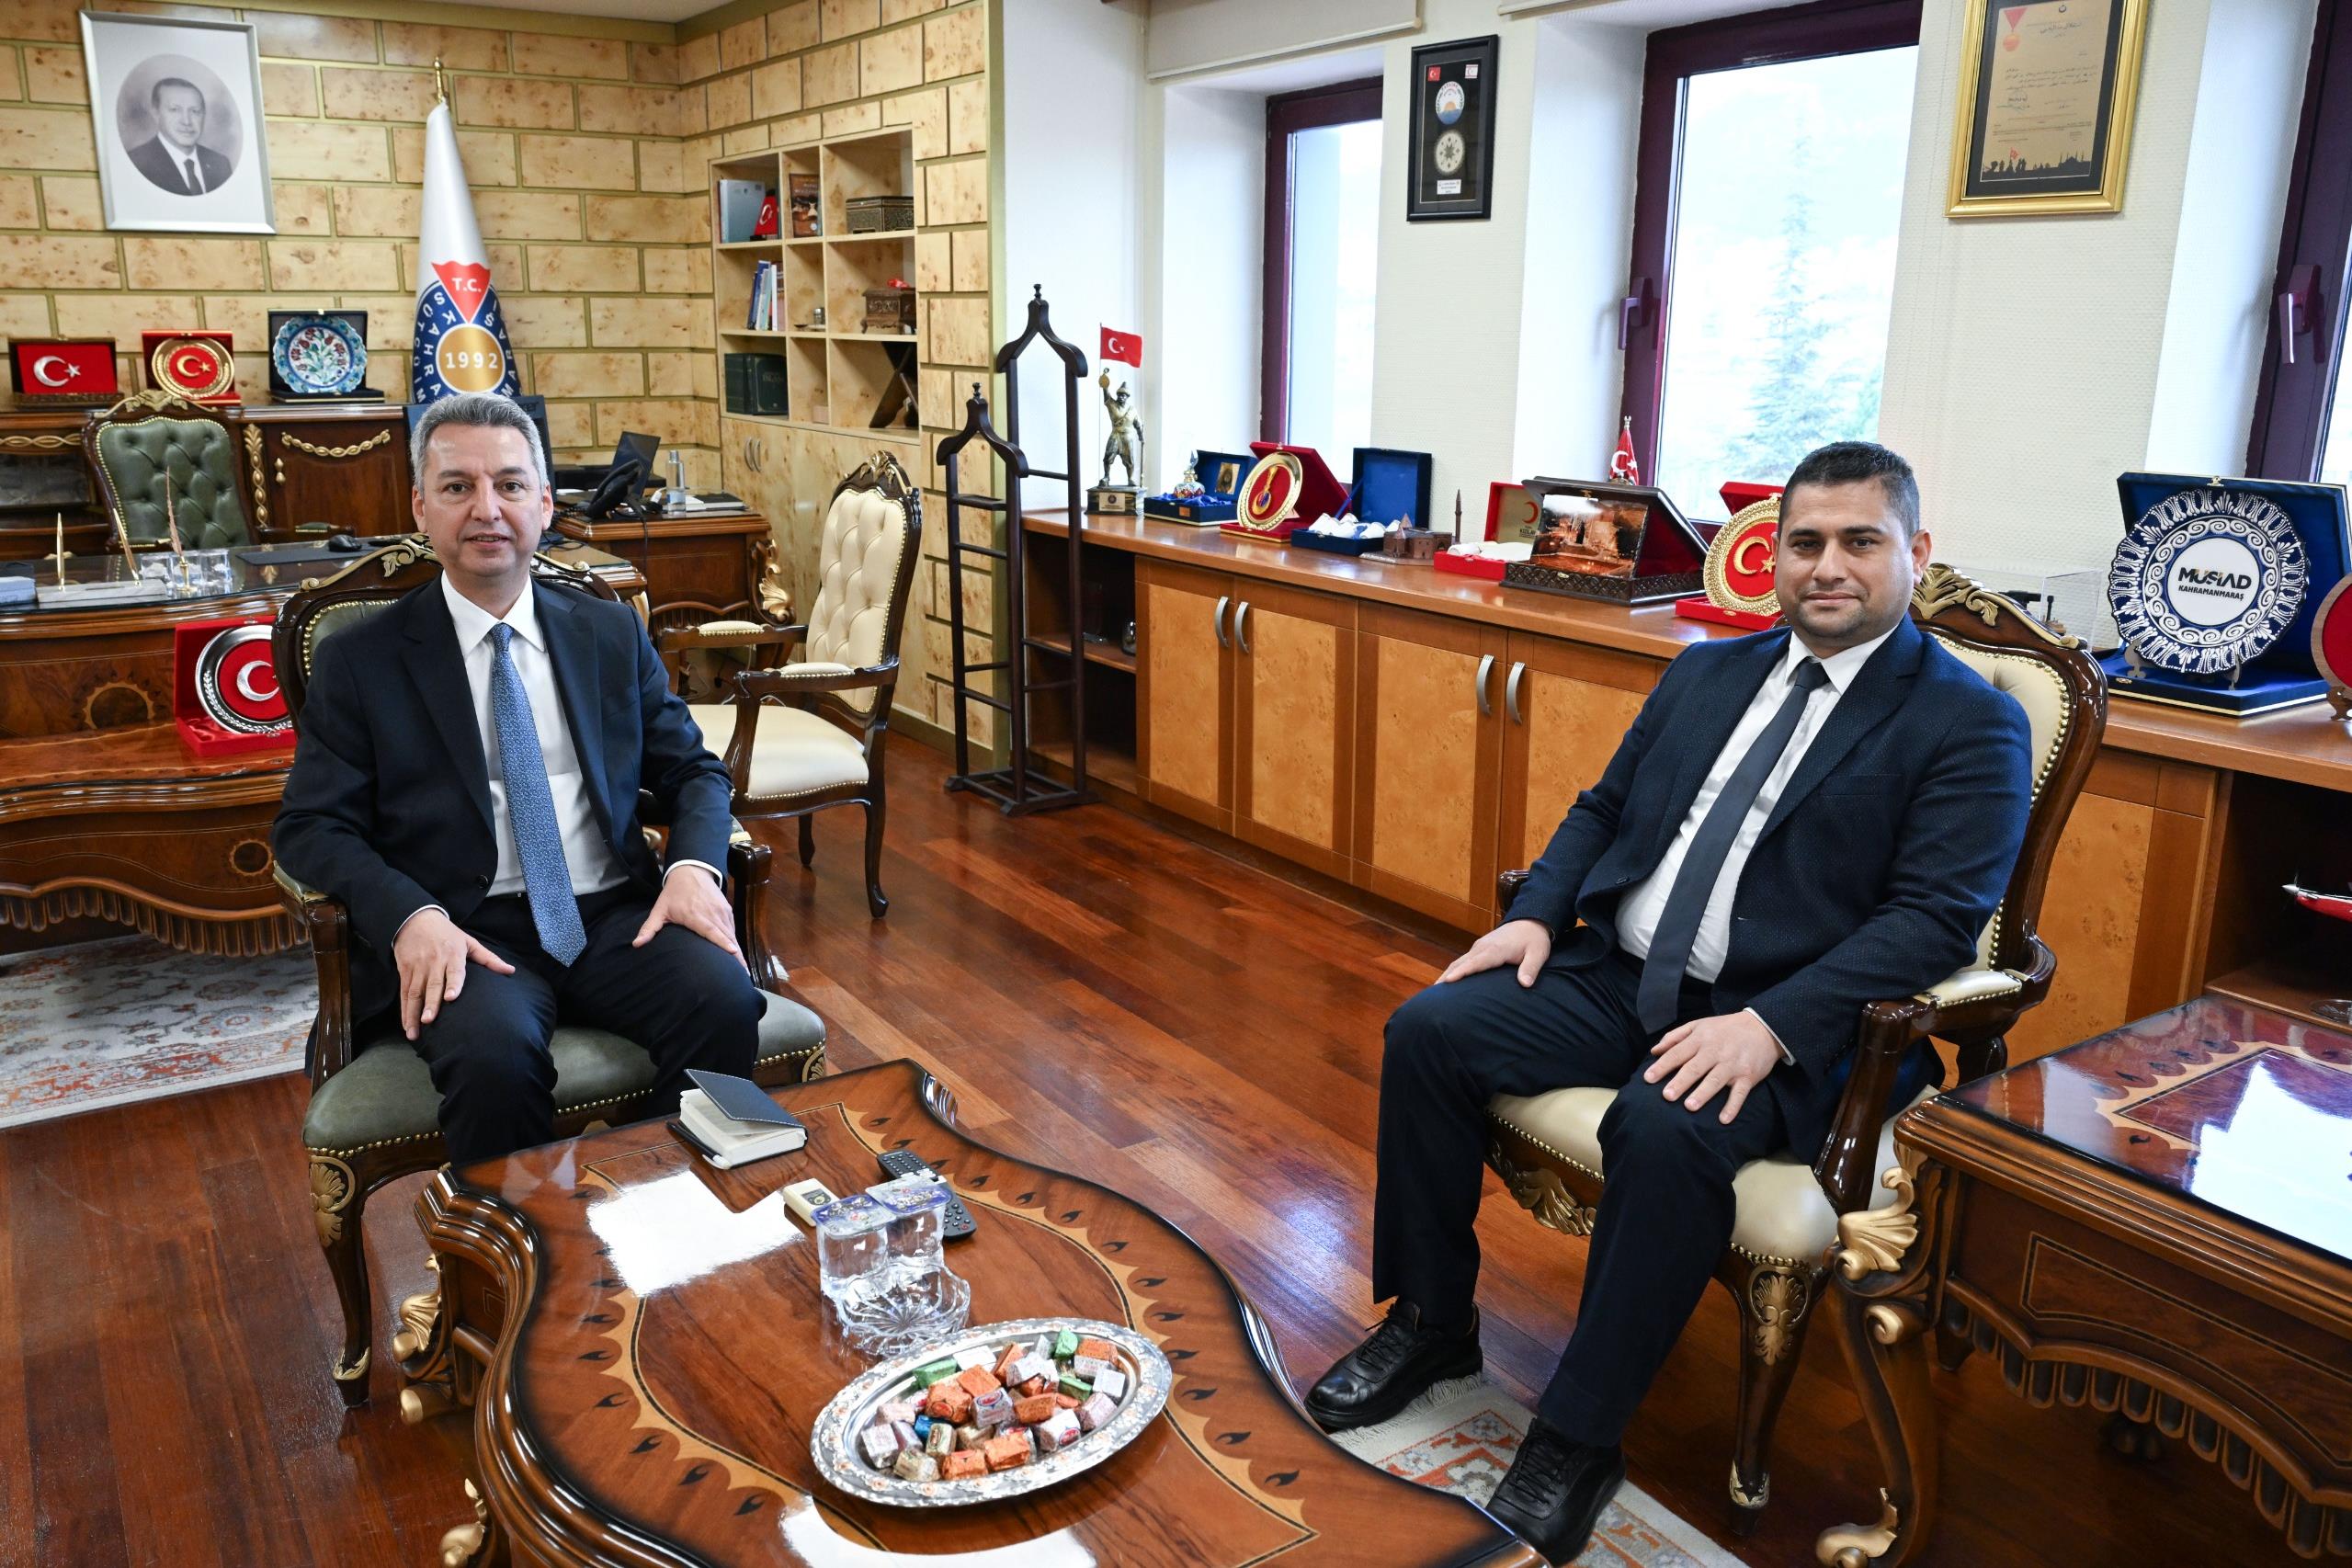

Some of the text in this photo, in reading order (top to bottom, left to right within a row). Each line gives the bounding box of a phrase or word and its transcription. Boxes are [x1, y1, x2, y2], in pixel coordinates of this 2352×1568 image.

[451, 278, 482, 292] T.C.
[446, 351, 498, 369] 1992
[2177, 585, 2244, 600] KAHRAMANMARAŞ
